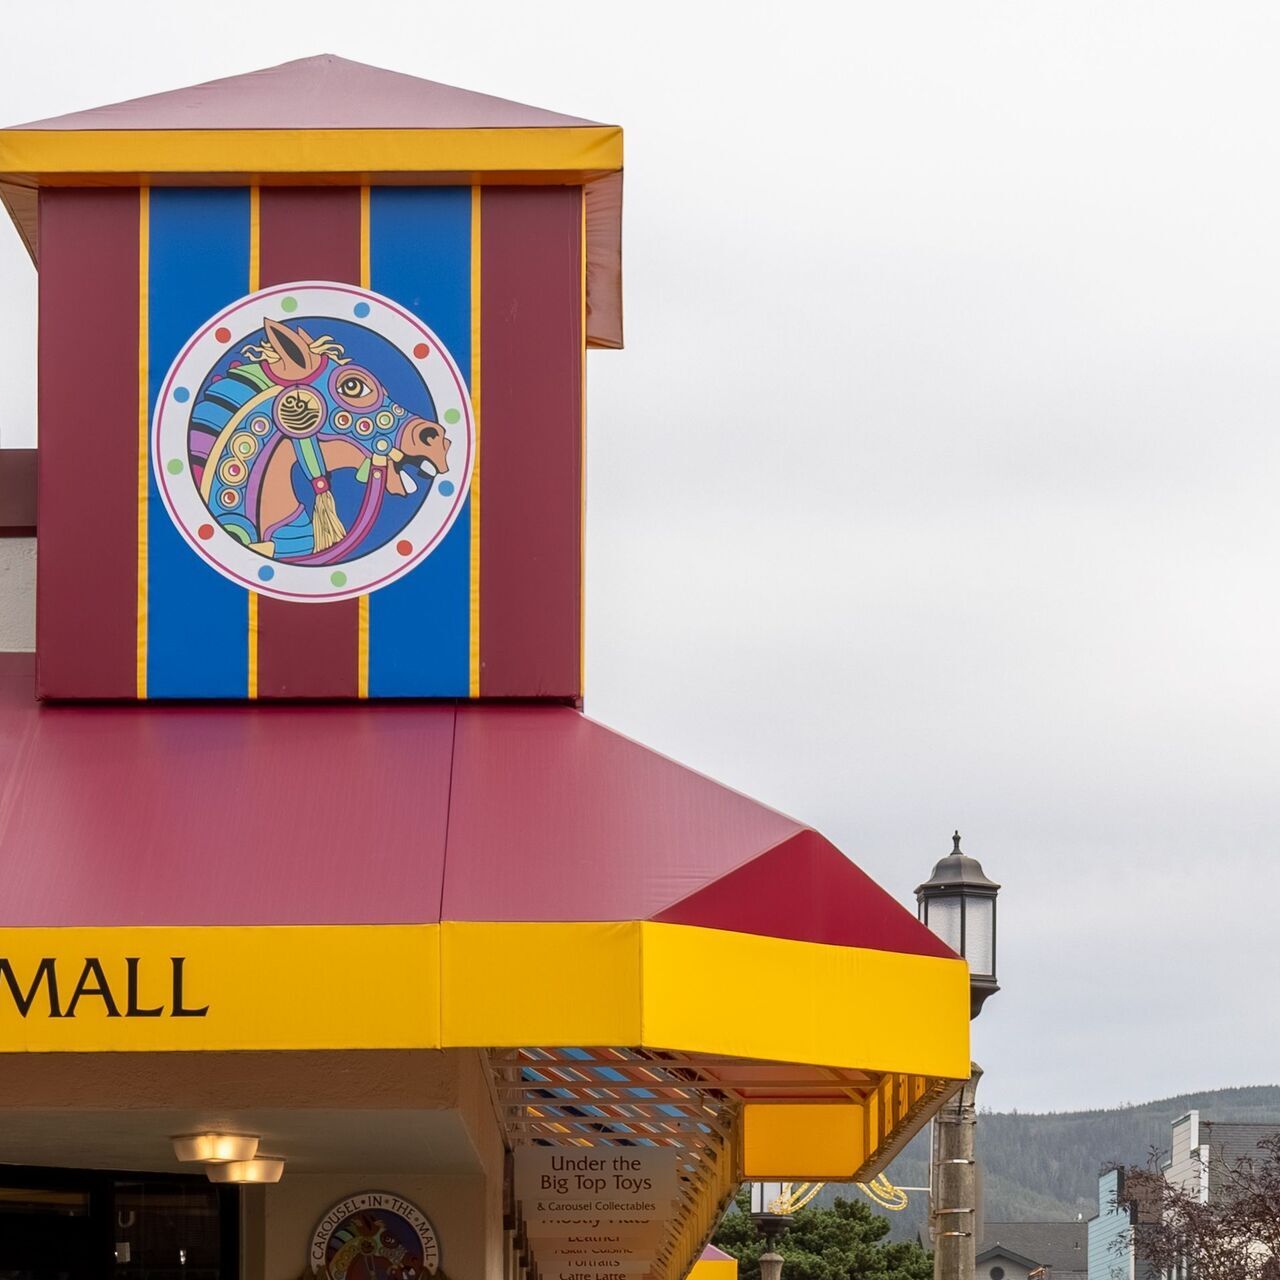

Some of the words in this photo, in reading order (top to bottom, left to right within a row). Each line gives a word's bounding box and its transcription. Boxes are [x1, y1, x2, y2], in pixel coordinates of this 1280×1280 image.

[551, 1156, 606, 1171] Under
[613, 1156, 641, 1171] the
[541, 1175, 568, 1194] Big
[575, 1175, 606, 1193] Top
[613, 1175, 652, 1193] Toys
[537, 1202, 545, 1211] &
[548, 1202, 592, 1211] Carousel
[595, 1202, 656, 1211] Collectables
[312, 1200, 361, 1260] CAROUSEL
[368, 1196, 382, 1206] IN
[391, 1198, 415, 1220] THE
[415, 1222, 436, 1260] MALL
